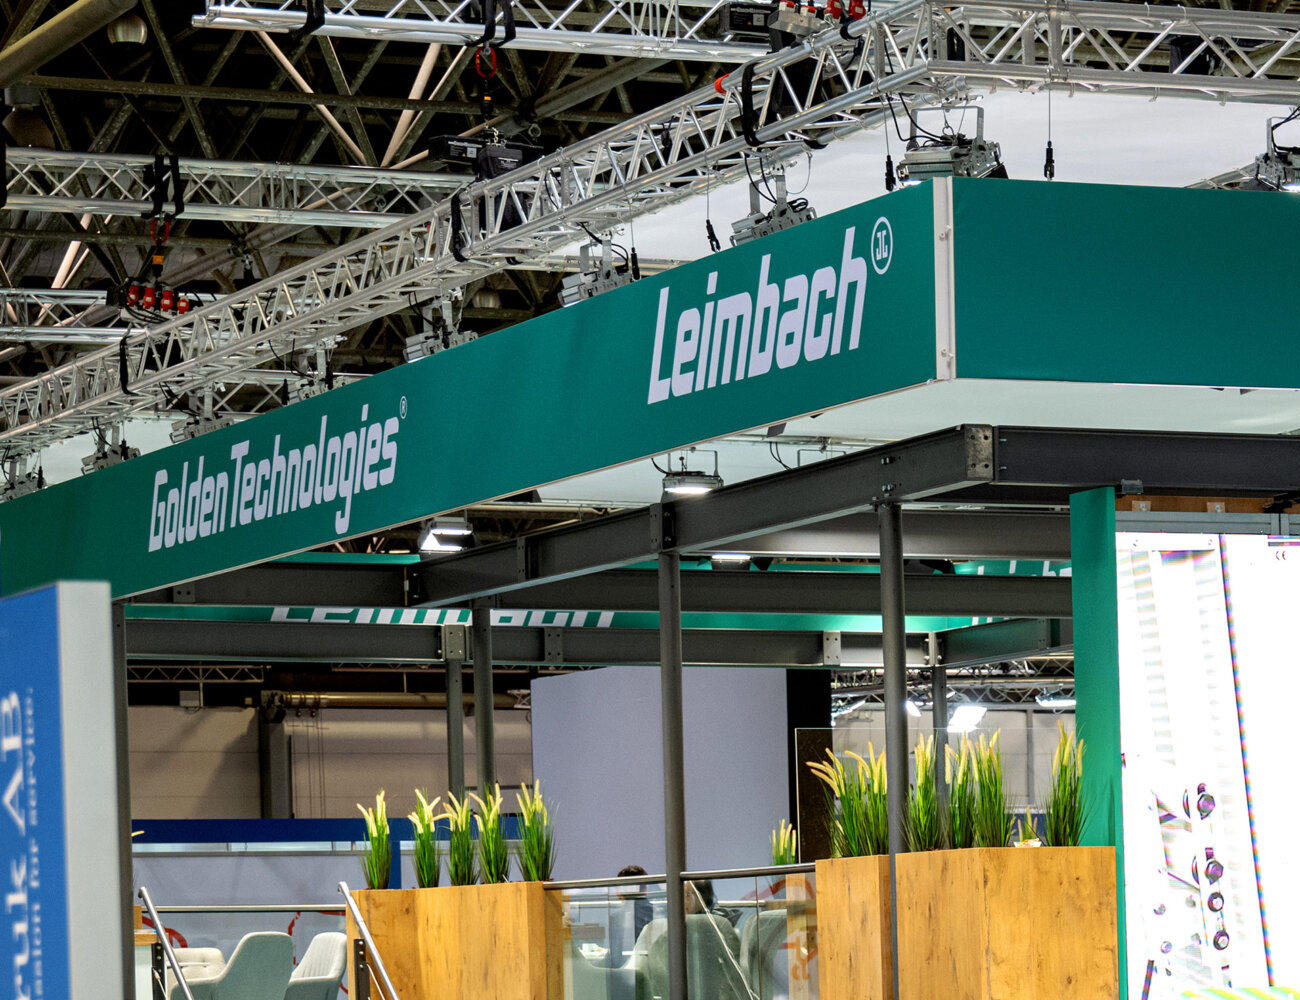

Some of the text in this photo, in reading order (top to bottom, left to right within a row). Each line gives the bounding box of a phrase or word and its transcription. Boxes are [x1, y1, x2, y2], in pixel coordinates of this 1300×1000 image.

[648, 226, 868, 405] Leimbach
[148, 455, 229, 552] Golden
[1, 691, 26, 836] AB
[29, 838, 40, 888] for
